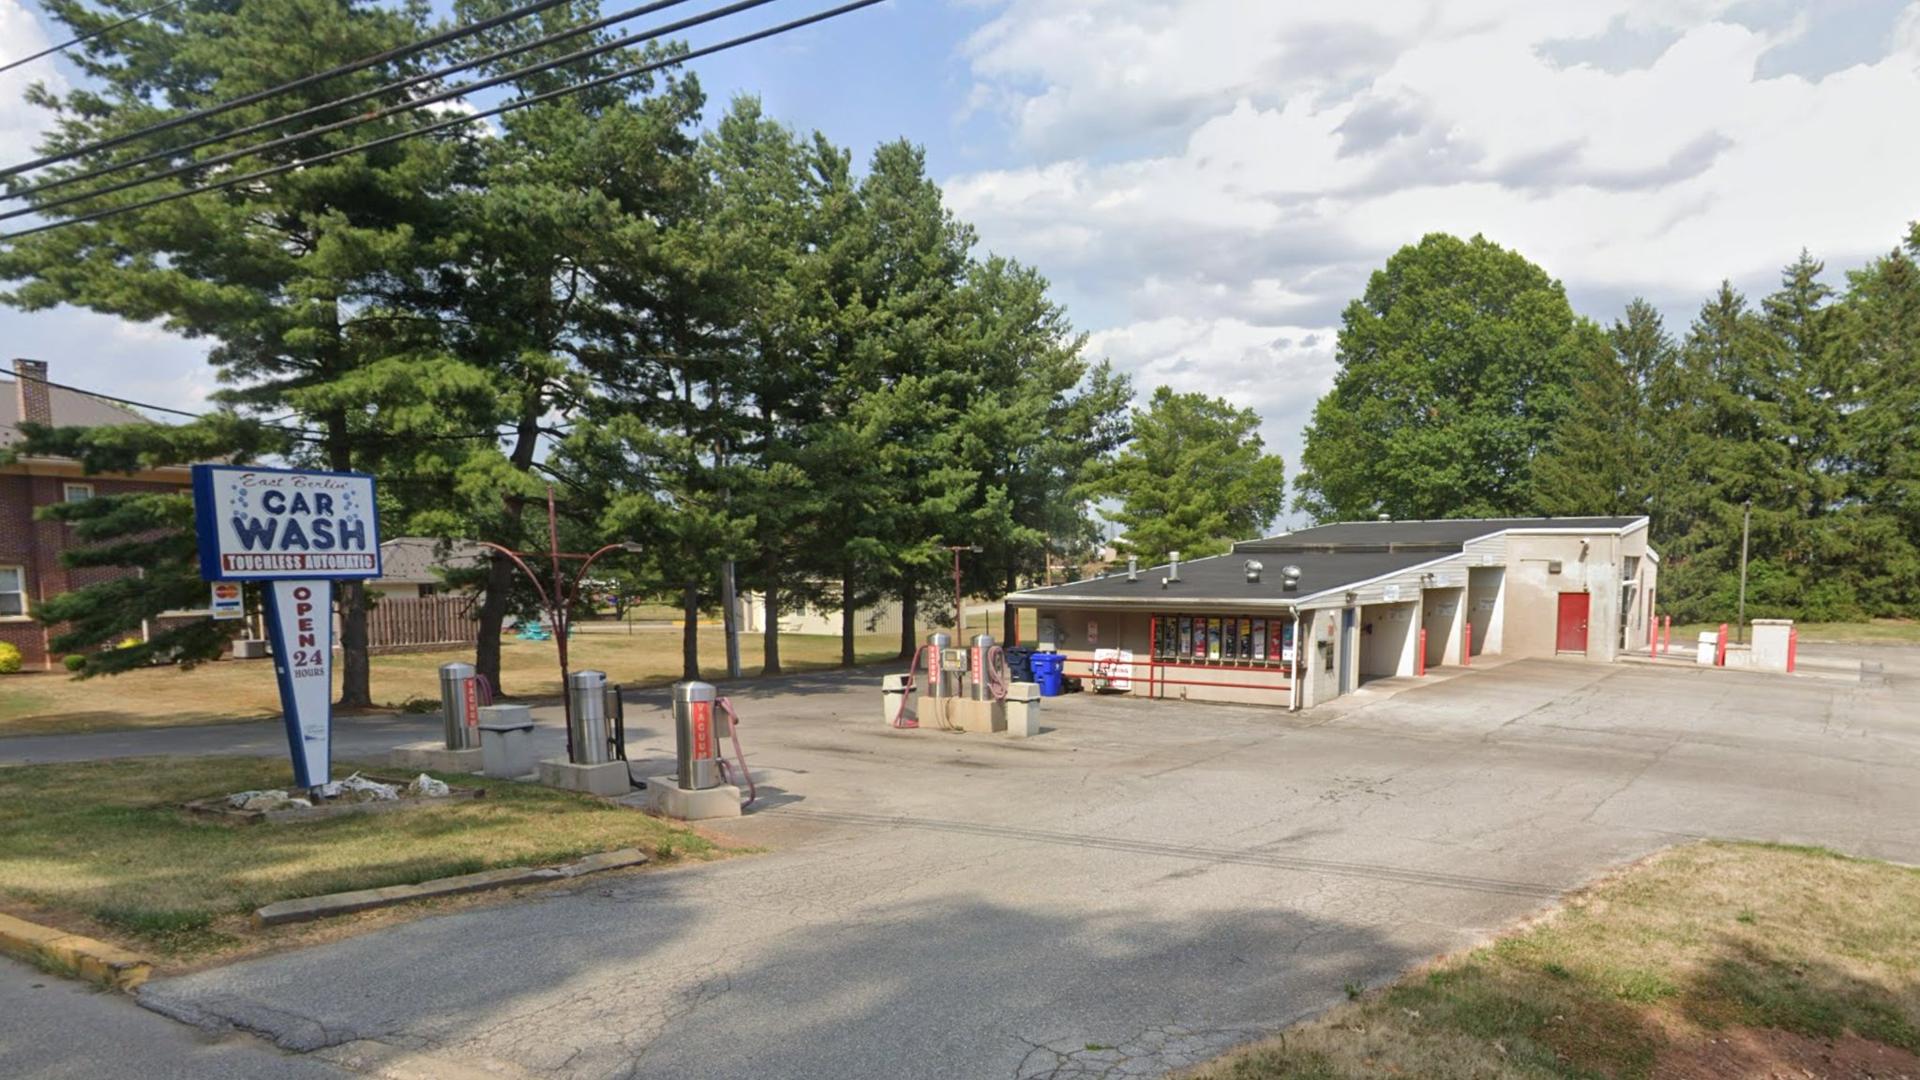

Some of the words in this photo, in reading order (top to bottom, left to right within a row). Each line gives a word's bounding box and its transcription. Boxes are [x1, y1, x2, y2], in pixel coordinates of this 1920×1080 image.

[239, 473, 284, 488] East
[291, 475, 348, 489] Berlin
[262, 490, 334, 516] CAR
[231, 517, 366, 551] WASH
[228, 554, 302, 571] TOUCHLESS
[305, 554, 373, 570] AUTOMATIC
[293, 586, 315, 648] OPEN
[292, 650, 323, 667] 24
[294, 668, 325, 679] HOURS
